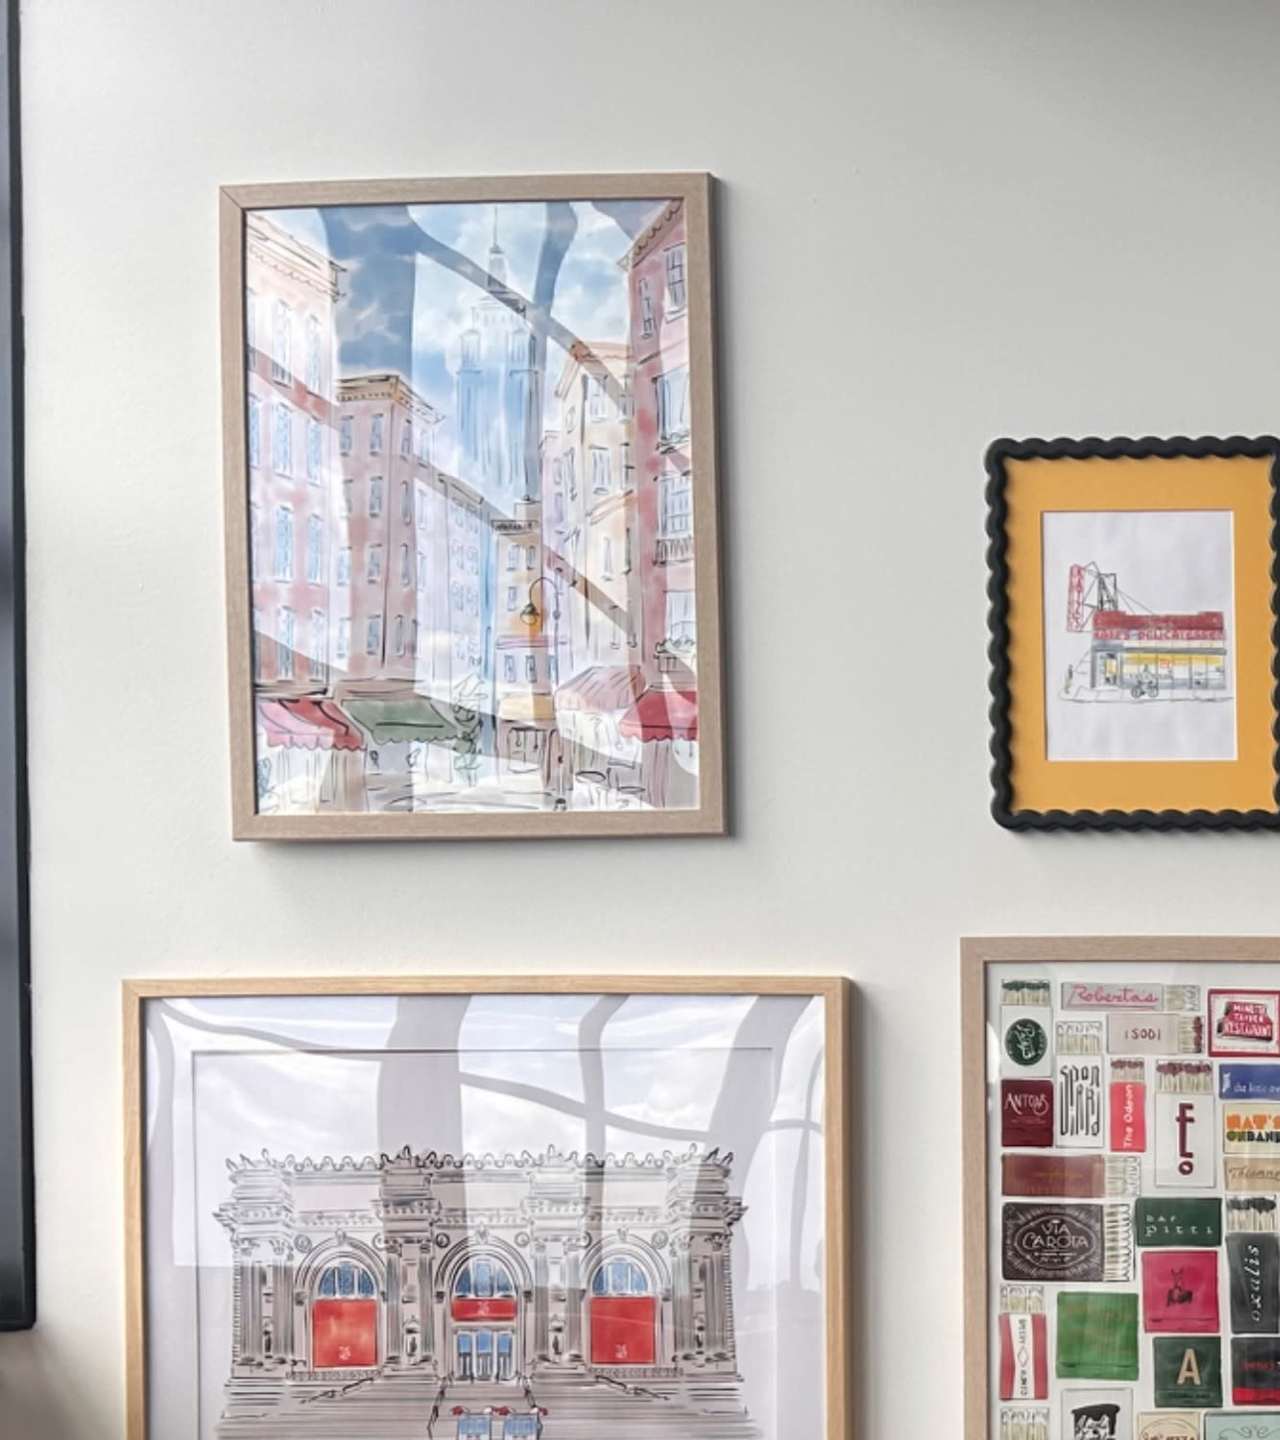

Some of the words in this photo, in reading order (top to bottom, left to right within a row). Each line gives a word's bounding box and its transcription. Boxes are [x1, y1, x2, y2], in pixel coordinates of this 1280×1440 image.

[1022, 1231, 1089, 1249] CAROTA
[1041, 1222, 1069, 1236] VIA
[1243, 1244, 1262, 1322] oxalis
[1177, 1348, 1202, 1386] A
